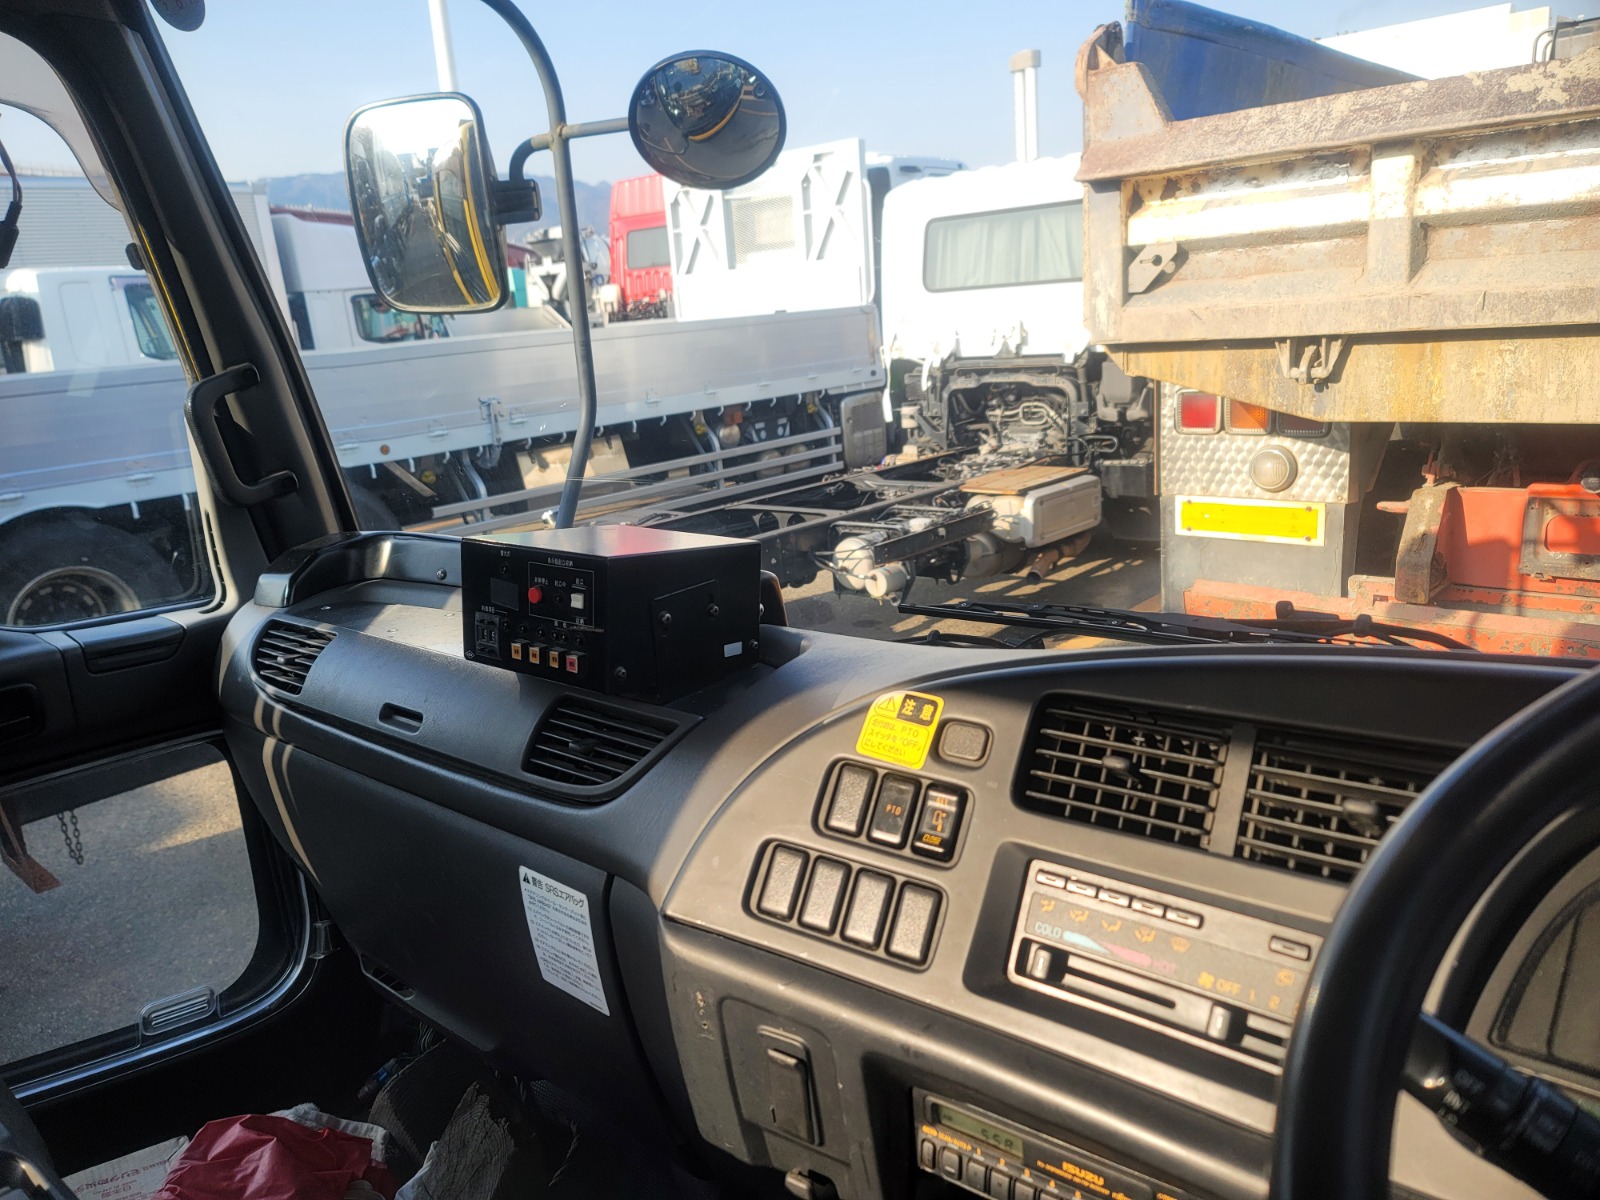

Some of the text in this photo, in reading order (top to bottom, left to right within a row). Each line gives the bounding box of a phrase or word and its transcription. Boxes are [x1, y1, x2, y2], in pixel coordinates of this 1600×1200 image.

[901, 698, 935, 722] 注意
[885, 804, 901, 816] PTO
[544, 882, 585, 908] SRSエアバッグ
[1034, 921, 1062, 940] COLD
[1216, 978, 1242, 996] OFF
[1062, 1160, 1105, 1187] ISUZU
